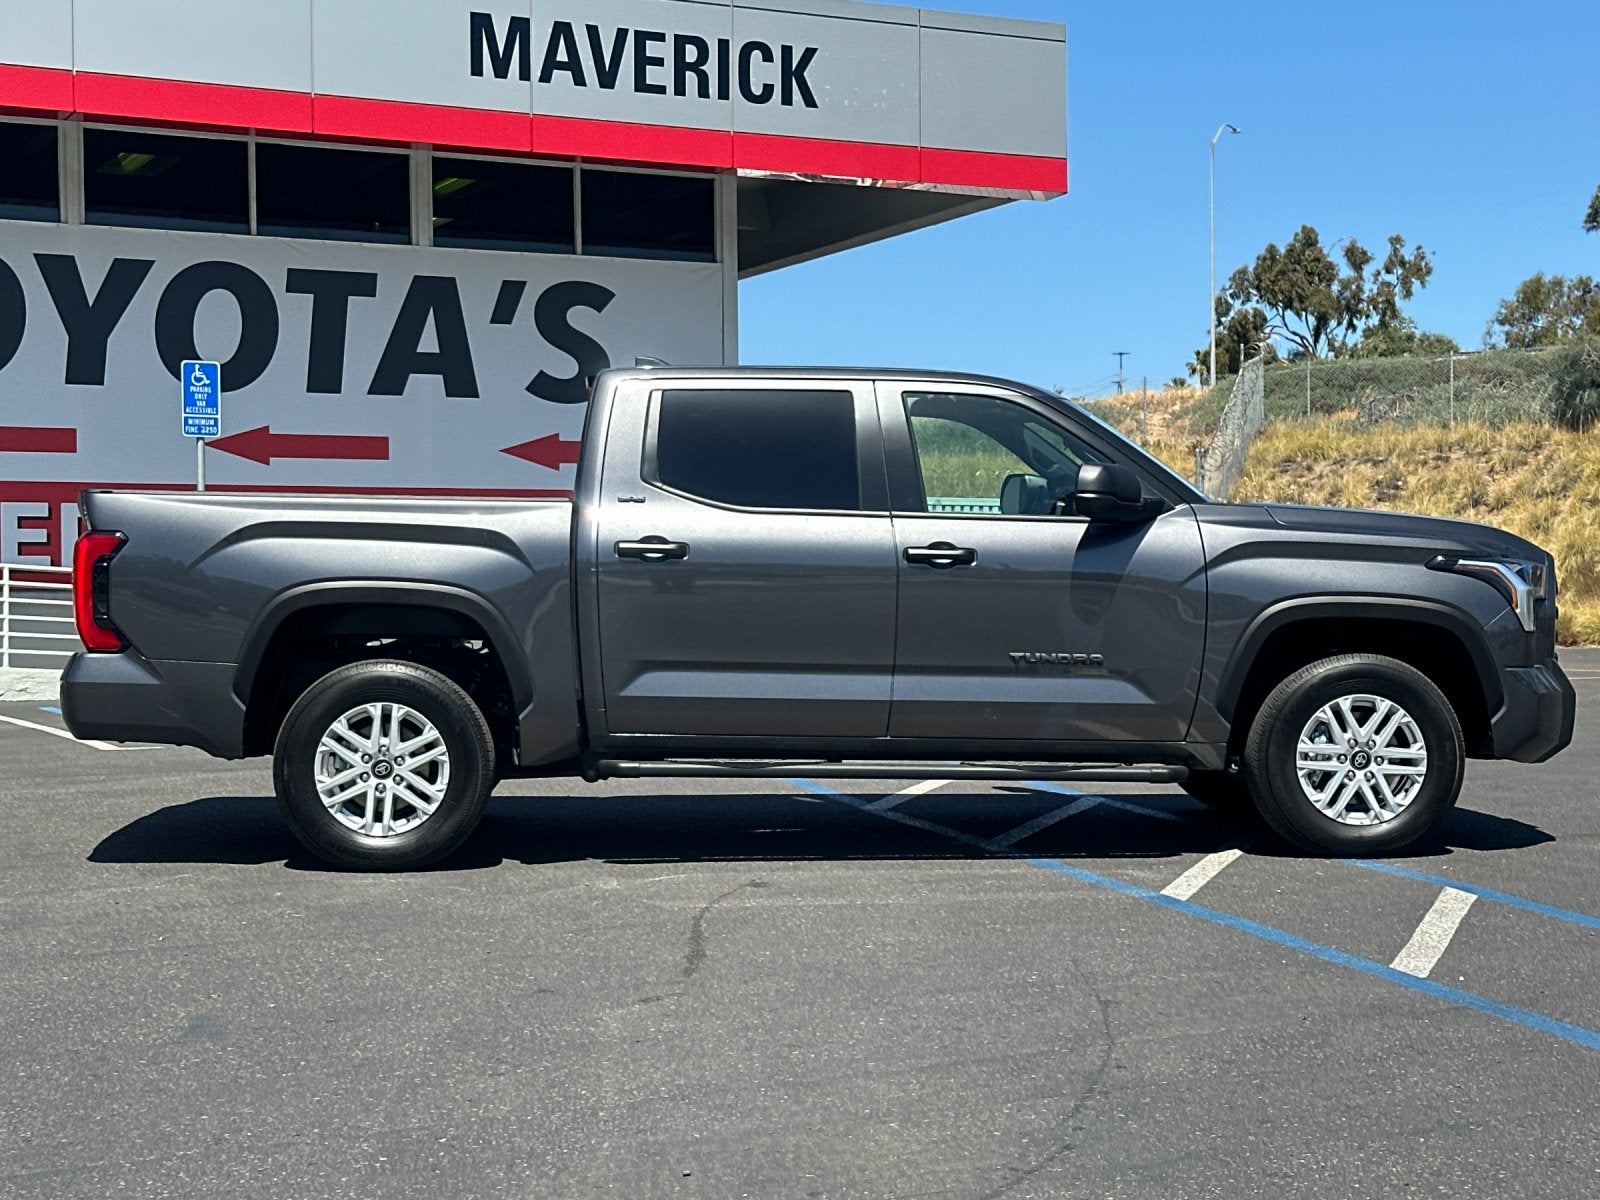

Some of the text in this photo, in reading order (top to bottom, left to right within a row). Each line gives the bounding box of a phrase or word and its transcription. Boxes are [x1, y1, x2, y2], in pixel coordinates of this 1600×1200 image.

[470, 12, 819, 110] MAVERICK
[185, 406, 217, 414] ACCESSIBLE
[188, 418, 215, 426] MINIMUM
[1008, 651, 1105, 666] TUNDRA
